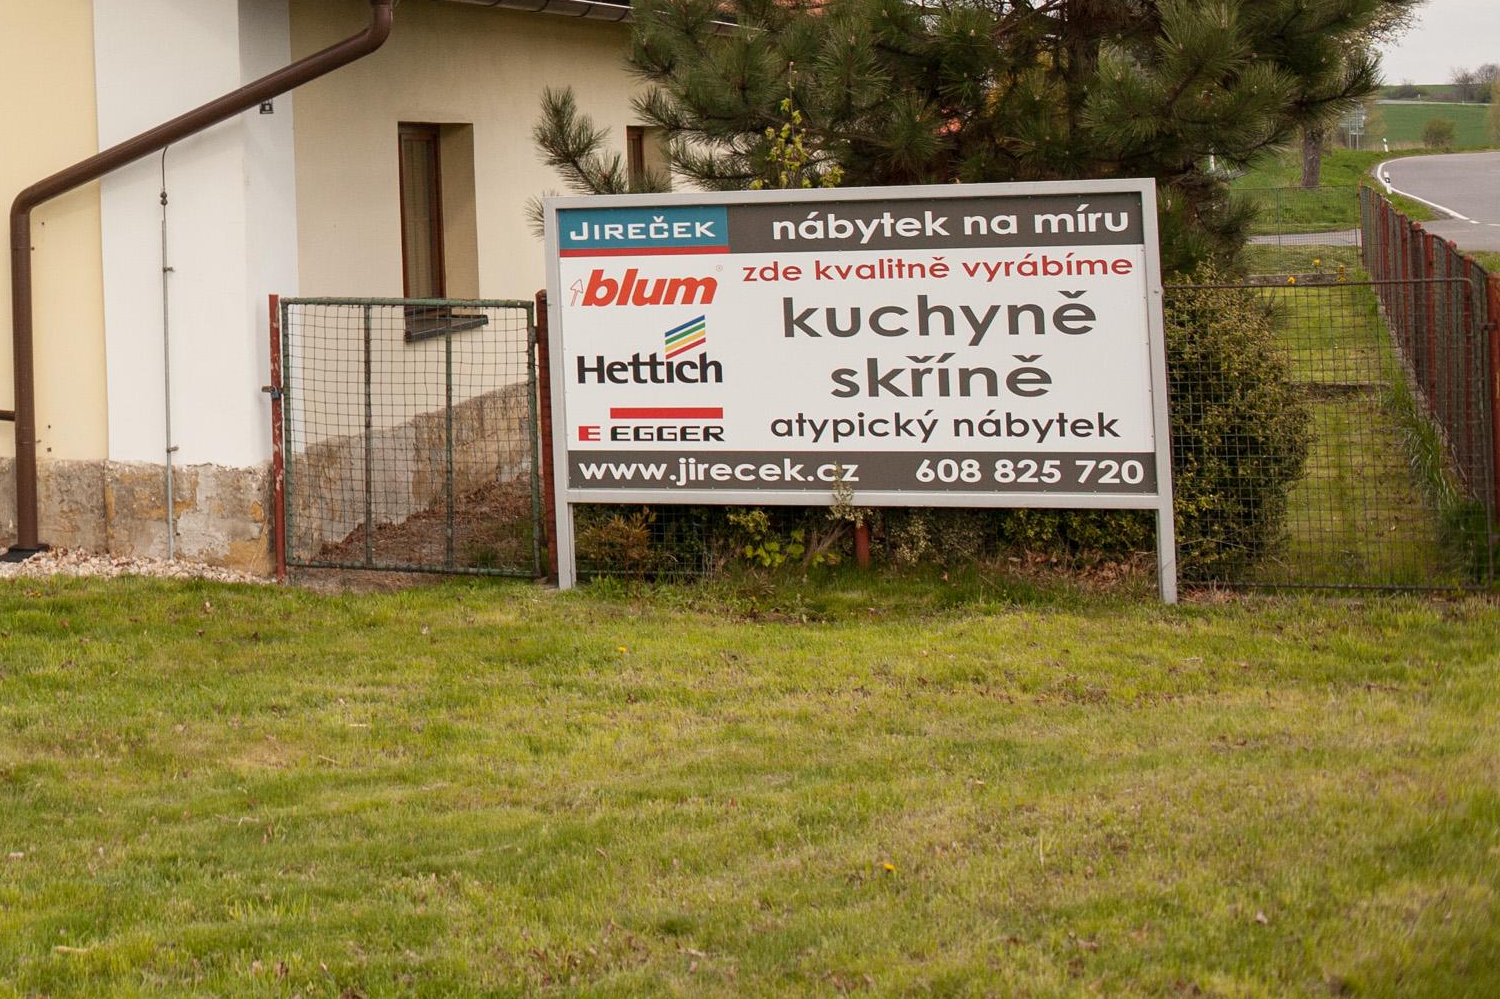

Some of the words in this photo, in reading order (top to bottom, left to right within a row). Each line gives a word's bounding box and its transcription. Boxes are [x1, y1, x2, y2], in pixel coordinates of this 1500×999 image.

[569, 215, 716, 241] JIREČEK
[772, 209, 950, 244] nábytek
[963, 210, 1018, 235] na
[1034, 203, 1129, 234] míru
[742, 261, 802, 282] zde
[814, 256, 950, 281] kvalitně
[961, 252, 1133, 282] vyrábíme
[581, 268, 718, 307] blum
[783, 290, 1096, 347] kuchyně
[576, 351, 724, 384] Hettich
[830, 352, 1053, 398] skříně
[610, 425, 725, 442] EGGER
[770, 409, 939, 444] atypický
[953, 408, 1121, 444] nábytek
[578, 457, 860, 487] www.jirecek.cz
[915, 459, 982, 484] 608
[994, 459, 1062, 484] 825
[1075, 459, 1144, 484] 720
